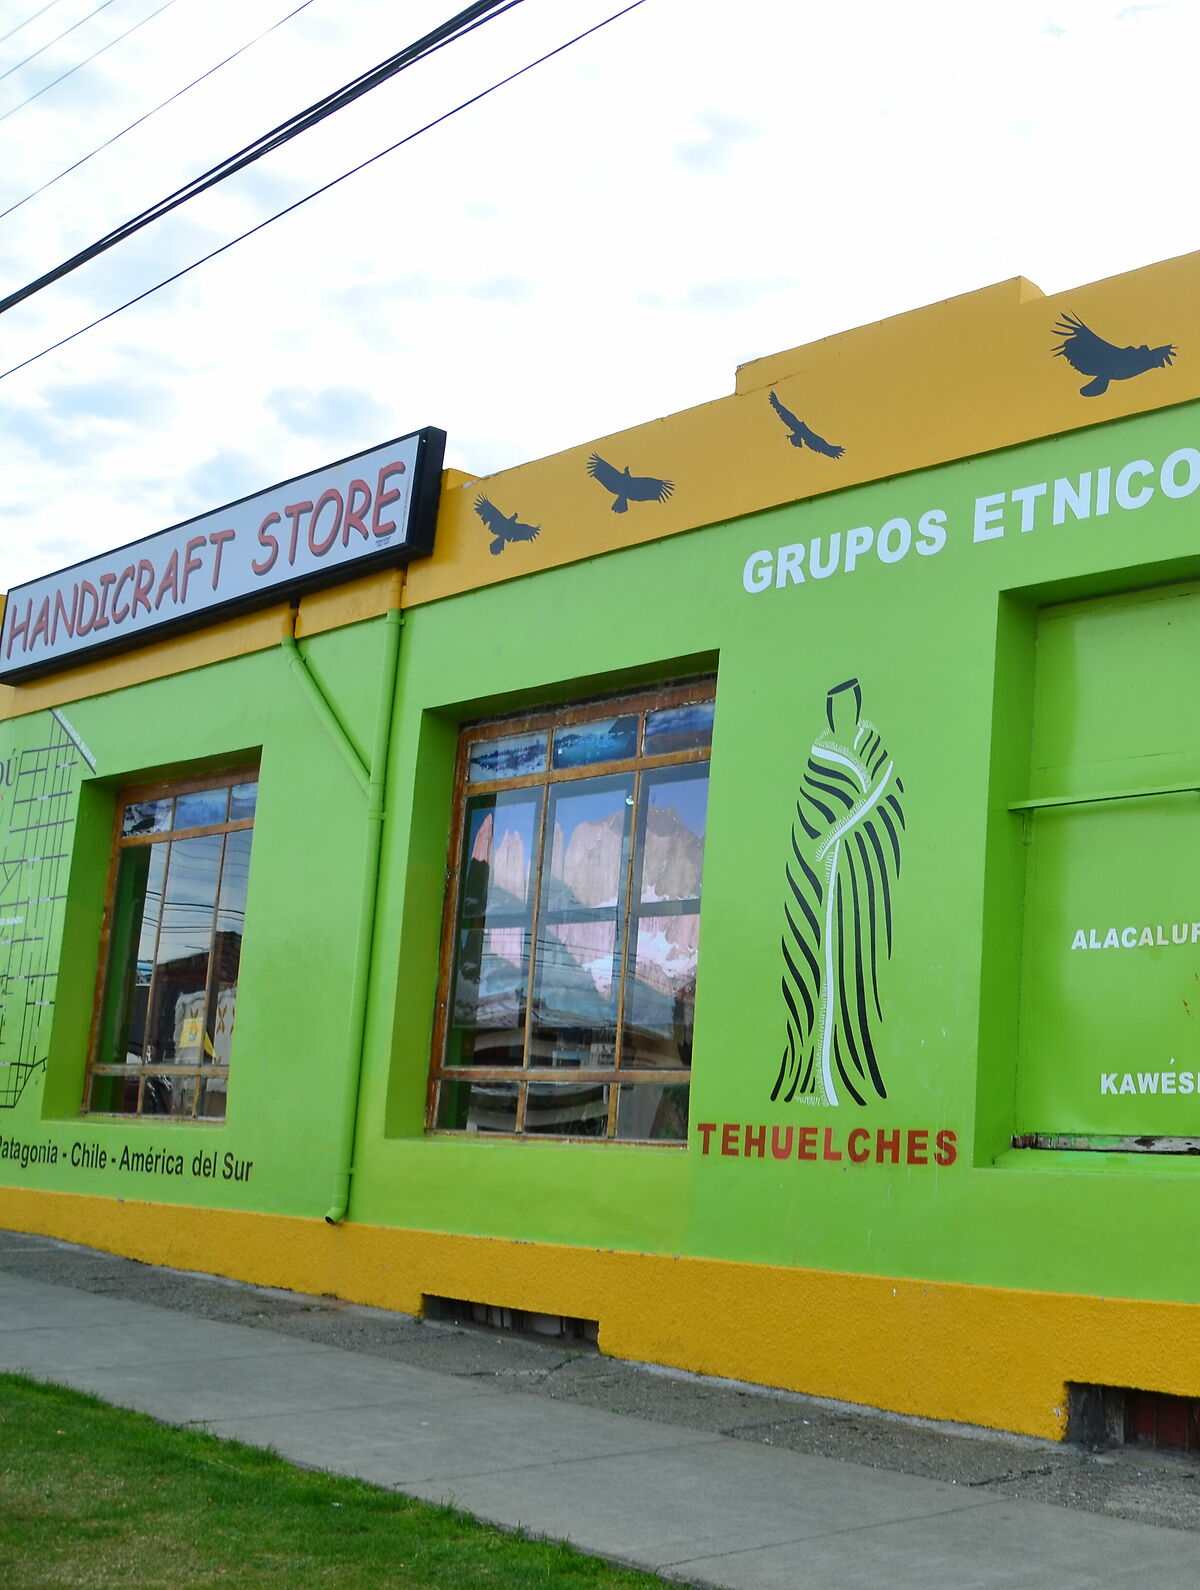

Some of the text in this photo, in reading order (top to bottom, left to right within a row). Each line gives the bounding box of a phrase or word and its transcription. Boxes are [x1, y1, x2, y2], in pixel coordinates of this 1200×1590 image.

[6, 461, 405, 661] HANDICRAFT STORE
[743, 509, 947, 593] GRUPOS
[71, 1142, 107, 1168] Chile
[119, 1146, 183, 1174] América
[192, 1151, 217, 1177] del
[222, 1152, 253, 1182] Sur
[698, 1123, 958, 1166] TEHUELCHES
